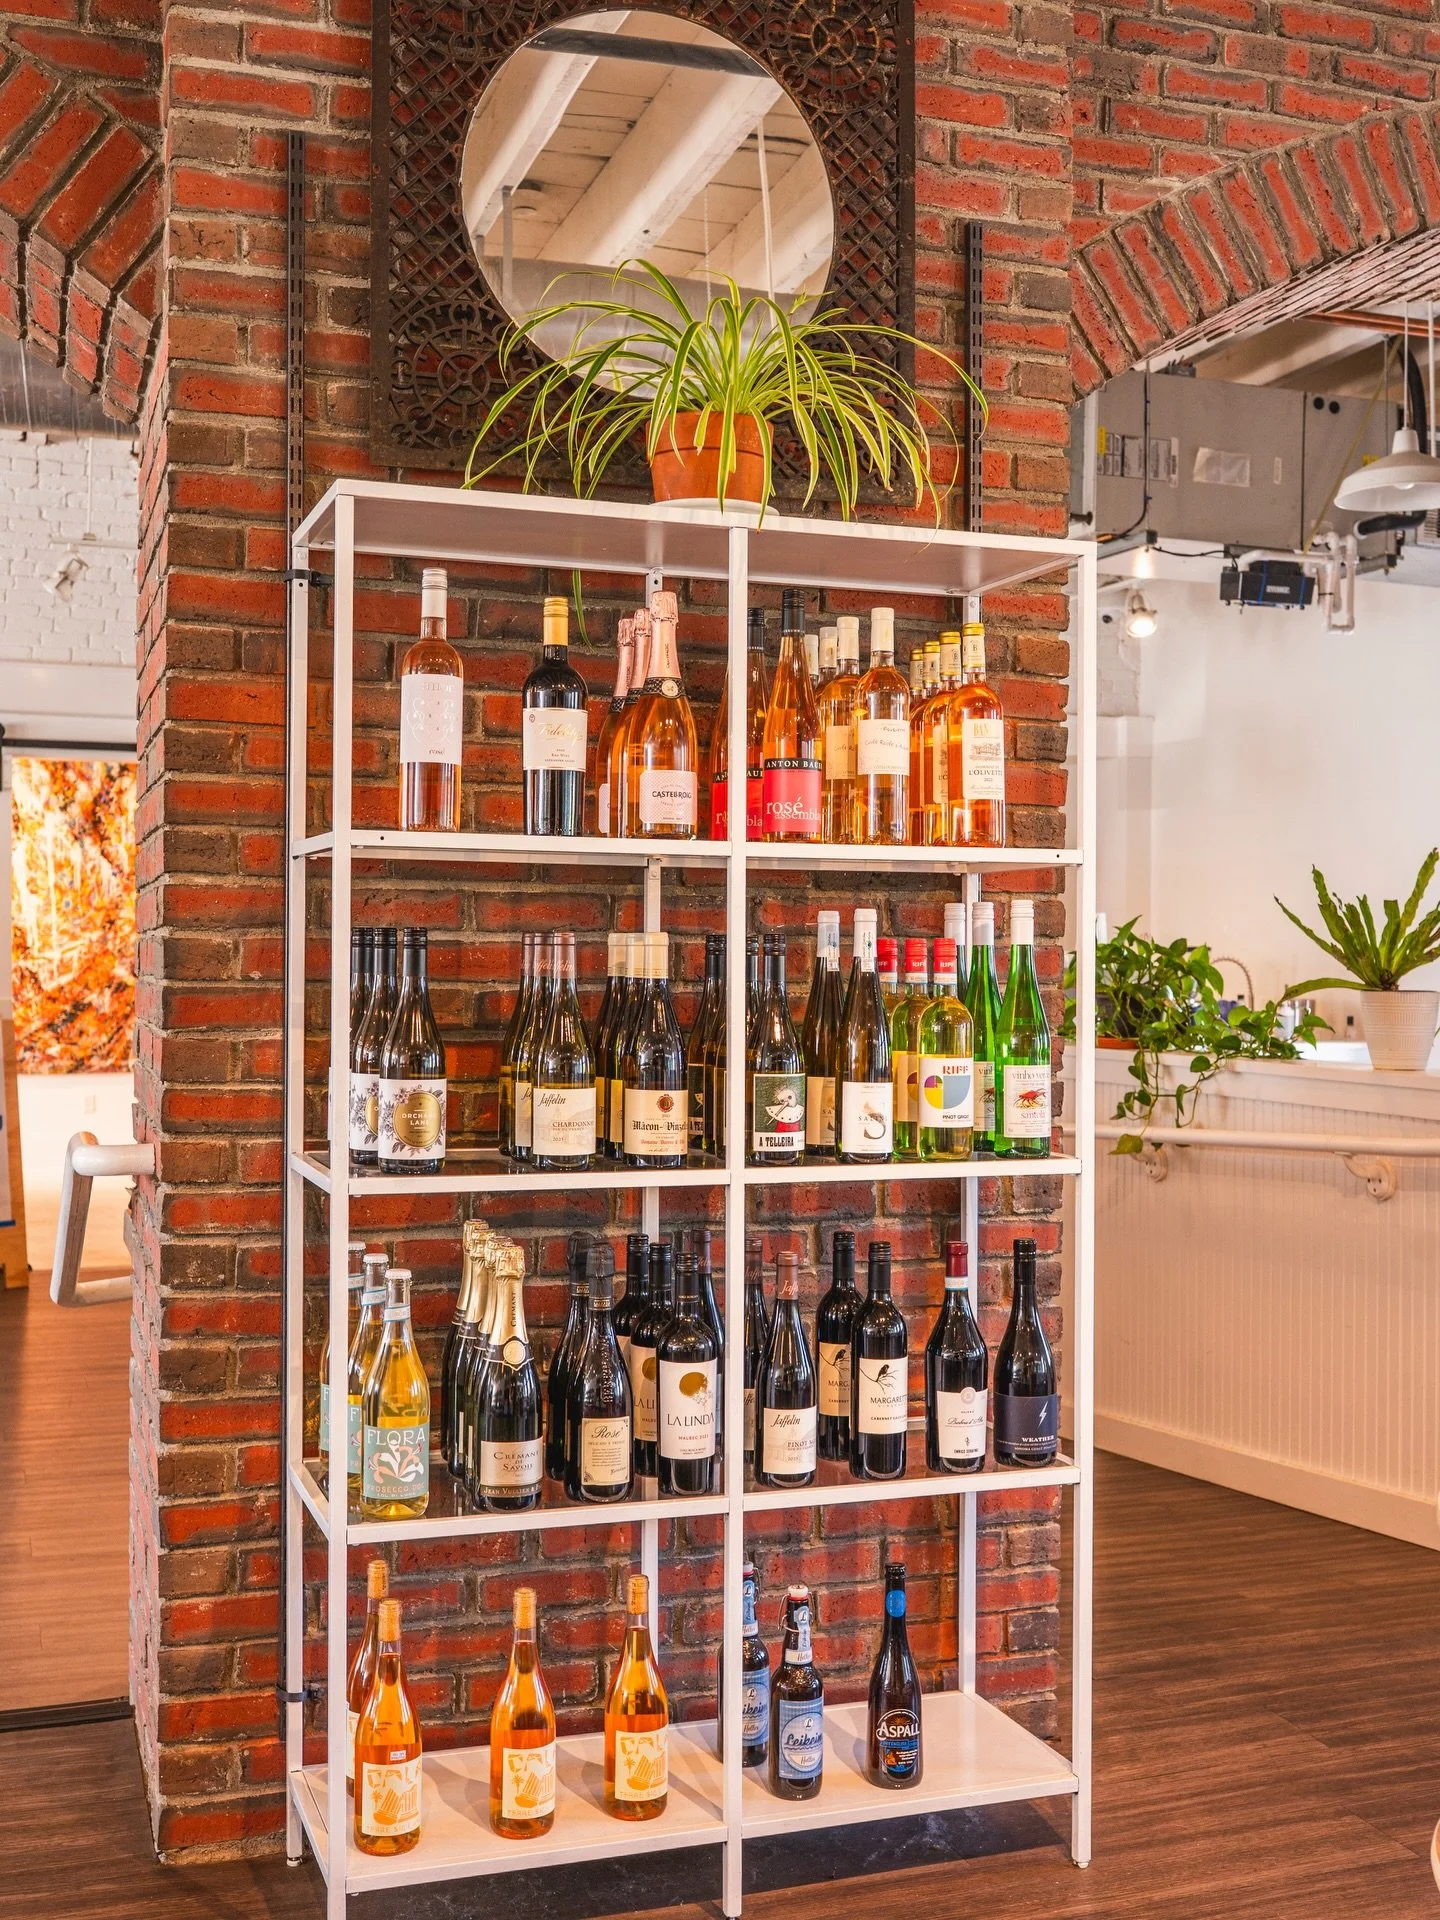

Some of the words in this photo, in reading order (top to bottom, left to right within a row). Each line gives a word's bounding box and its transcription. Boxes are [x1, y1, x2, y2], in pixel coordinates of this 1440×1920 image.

[766, 760, 799, 768] ANTON
[766, 797, 803, 815] rosé
[943, 1065, 969, 1074] RIFF
[538, 1093, 566, 1107] Jaffelin
[759, 1136, 763, 1147] A
[765, 1136, 794, 1147] TELLEIRA
[667, 1413, 682, 1426] LA
[684, 1412, 714, 1427] LINDA
[770, 1414, 800, 1427] Jaffelin
[367, 1428, 425, 1446] FLORA
[876, 1721, 920, 1740] ASPALL
